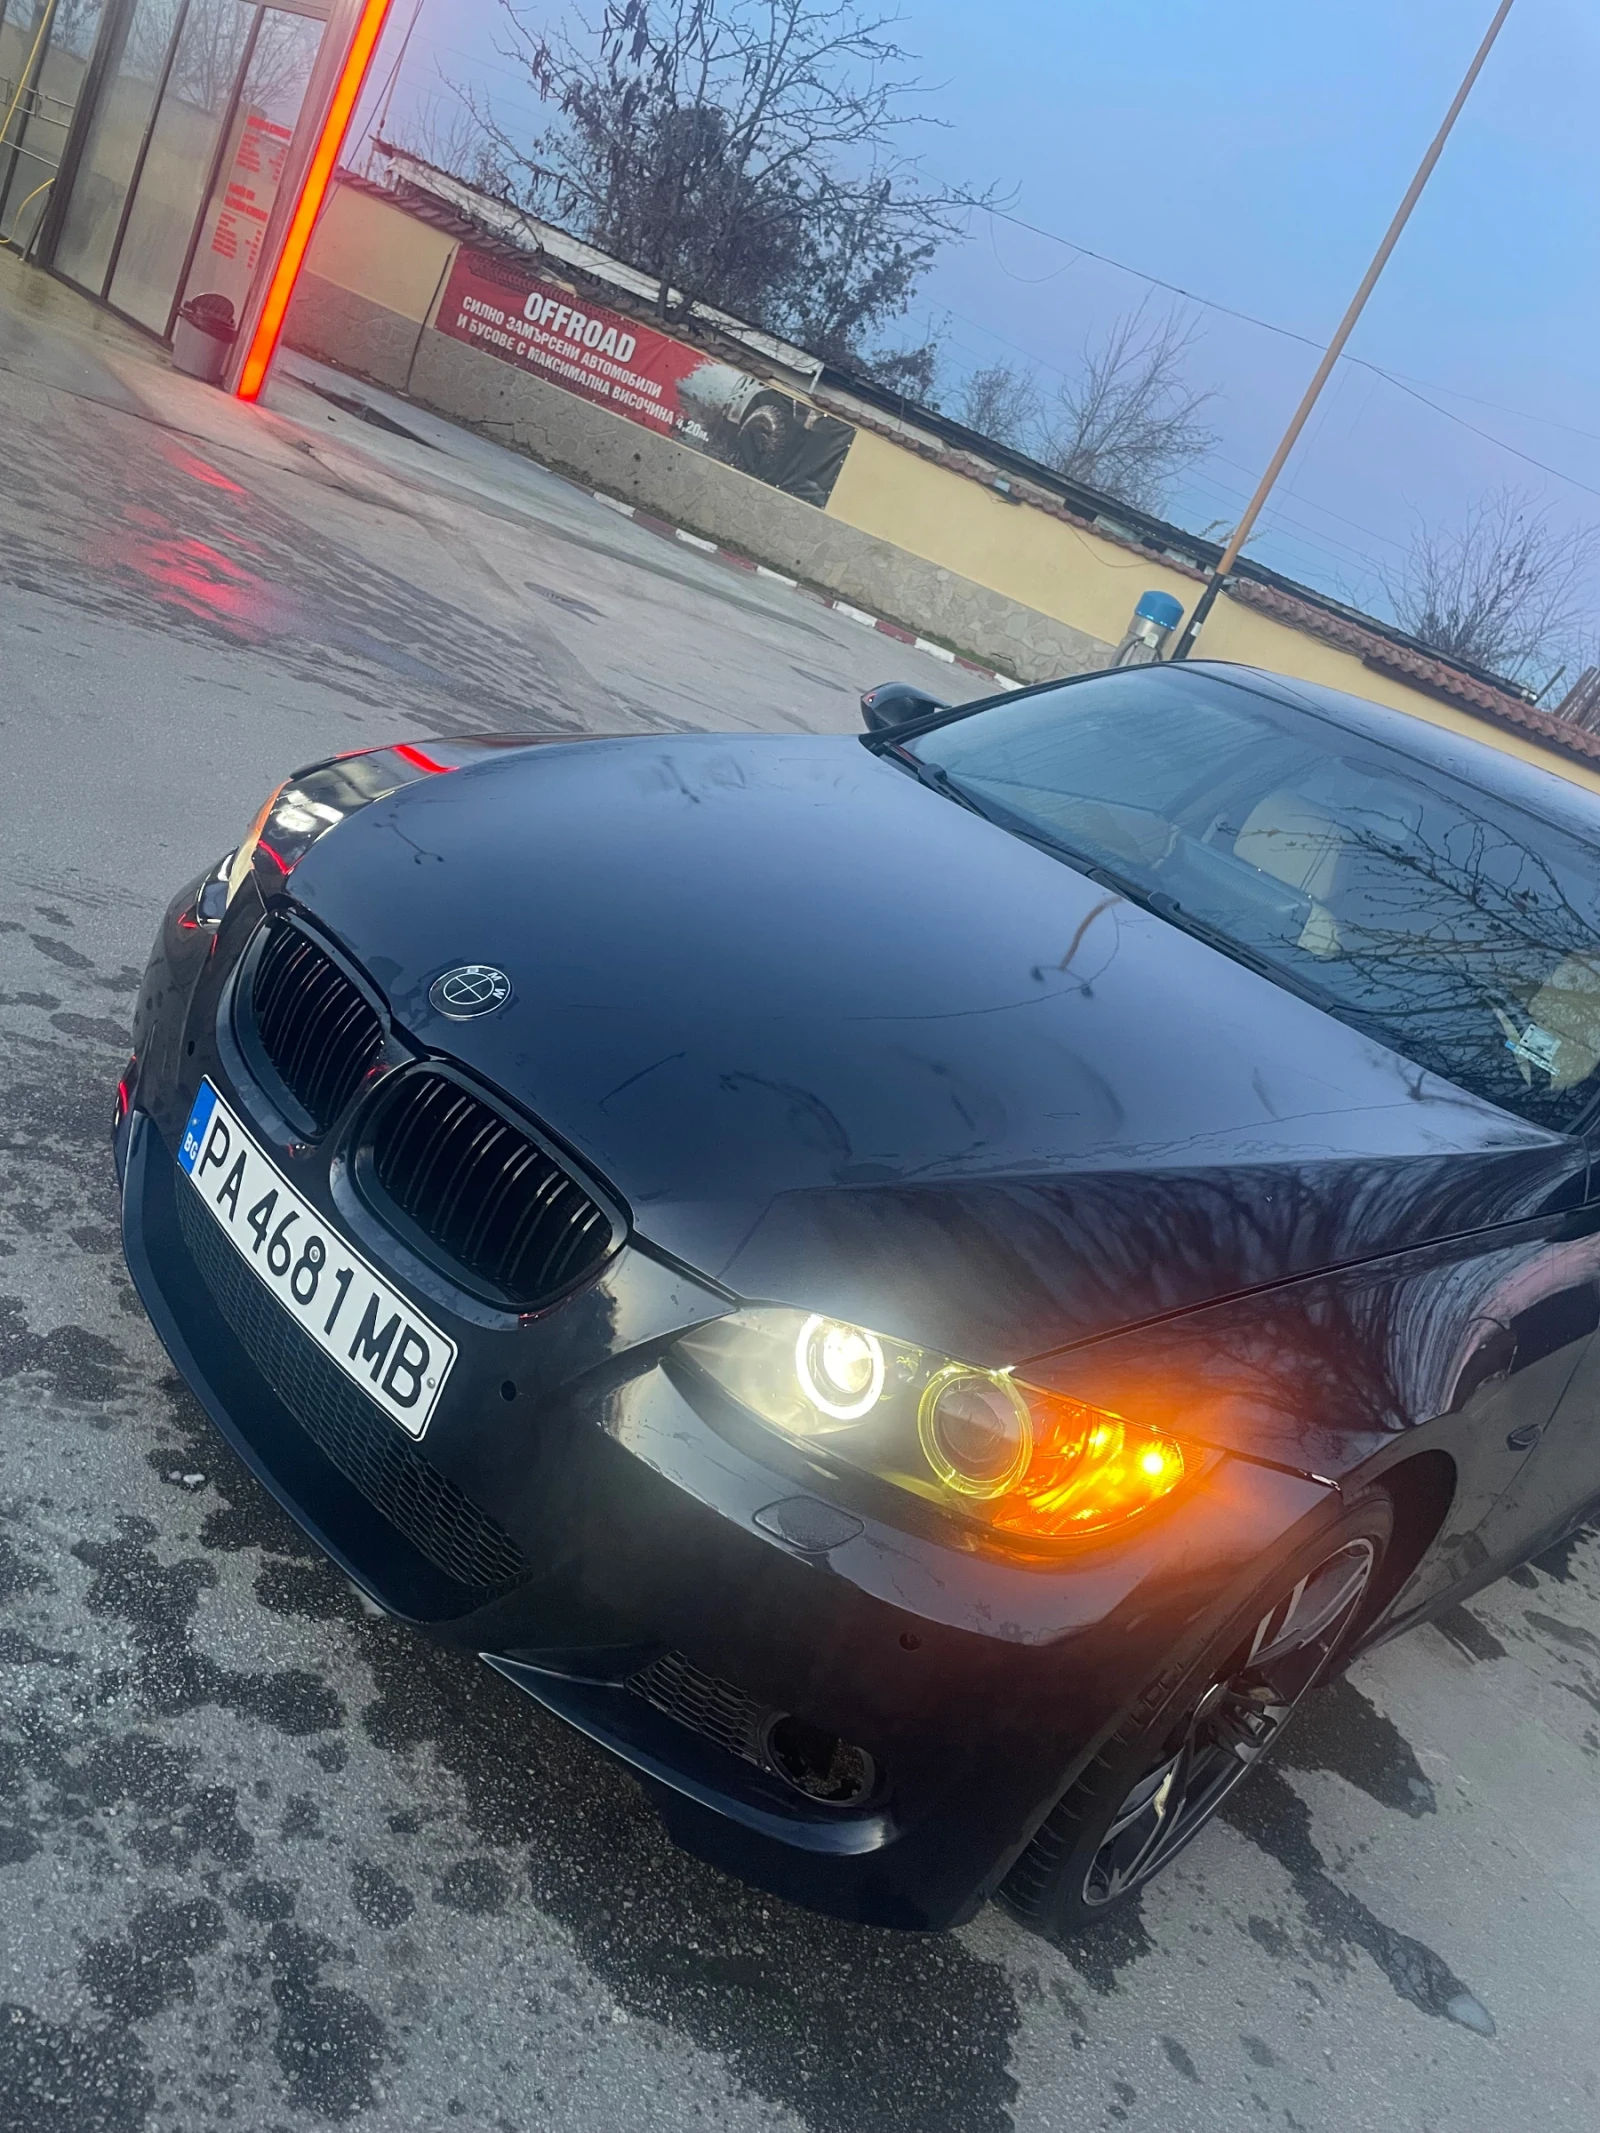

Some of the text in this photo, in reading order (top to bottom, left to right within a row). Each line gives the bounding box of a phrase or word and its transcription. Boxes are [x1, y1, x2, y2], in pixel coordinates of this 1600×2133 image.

[456, 313, 468, 329] И
[468, 319, 516, 351] БУСОВЕ
[516, 341, 526, 355] С
[527, 346, 611, 396] МАКСИМАЛНА
[611, 385, 675, 425] ВИСОЧИНА
[462, 296, 663, 399] СИЛНО ЗАМЪРСЕНИ АВТОМОБИЛИ
[523, 292, 636, 363] OFFROAD
[184, 1132, 199, 1161] BG
[198, 1115, 431, 1408] PA 4681 MB
